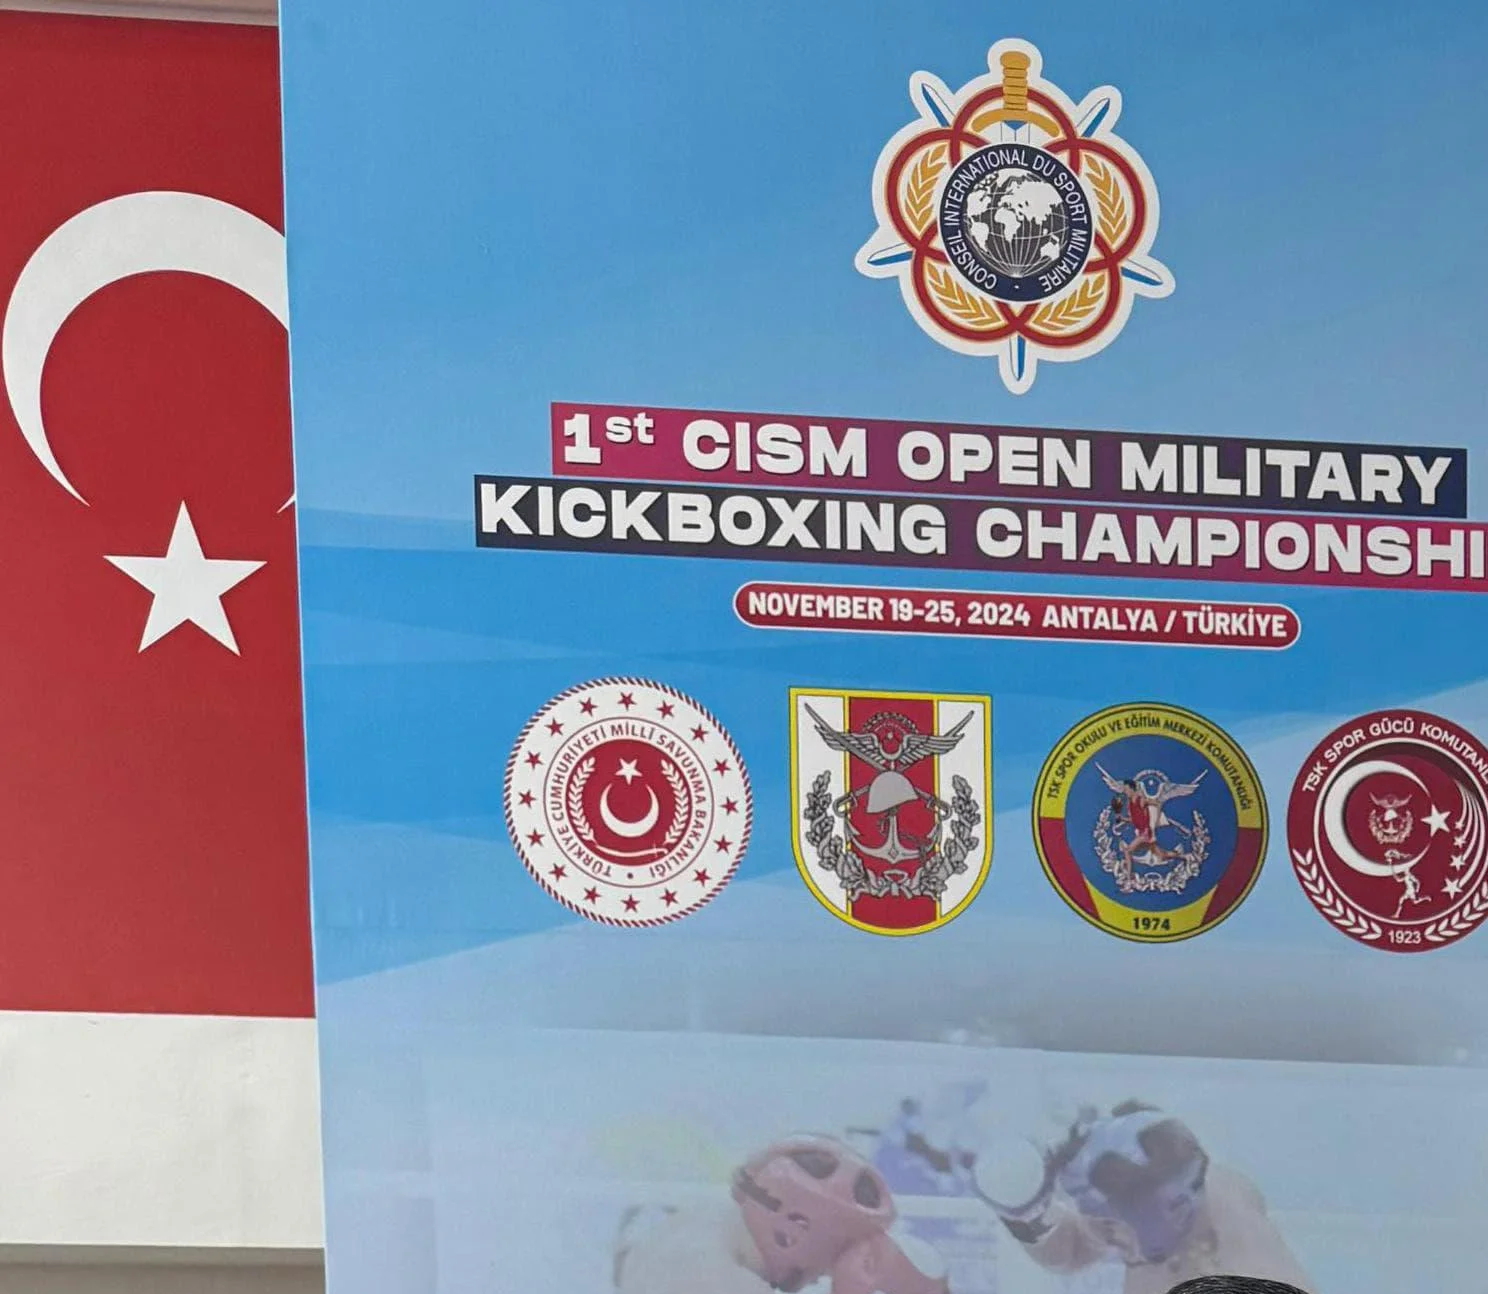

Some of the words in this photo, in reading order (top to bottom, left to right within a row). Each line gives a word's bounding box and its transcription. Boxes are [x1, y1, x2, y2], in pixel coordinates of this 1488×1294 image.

[944, 148, 1029, 226] INTERNATIONAL
[1032, 154, 1056, 177] DU
[1054, 172, 1087, 225] SPORT
[946, 231, 997, 290] CONSEIL
[1039, 228, 1088, 292] MILITAIRE
[564, 412, 656, 465] 1st
[682, 419, 868, 478] CISM
[898, 430, 1092, 490] OPEN
[1121, 442, 1452, 505] MILITARY
[480, 482, 947, 555] KICKBOXING
[748, 591, 883, 621] NOVEMBER
[891, 598, 962, 627] 19-25,
[967, 601, 1031, 627] 2024
[1042, 604, 1157, 632] ANTALYA
[1183, 606, 1287, 638] TÜRKİYE
[551, 726, 607, 821] CUMHURİYETİ
[657, 734, 706, 804] SAVUNMA
[1055, 752, 1077, 780] SPOR
[1109, 719, 1123, 734] VE
[1125, 714, 1160, 730] EĞİTİM
[1163, 719, 1210, 747] MERKEZİ
[1302, 761, 1328, 793] TSK
[1324, 728, 1366, 763] SPOR
[1369, 717, 1415, 737] GÜCÜ
[557, 826, 612, 877] TÜRKİYE
[649, 811, 707, 878] BAKANLIĞI
[1132, 916, 1171, 931] 1974
[1388, 929, 1422, 945] 1923
